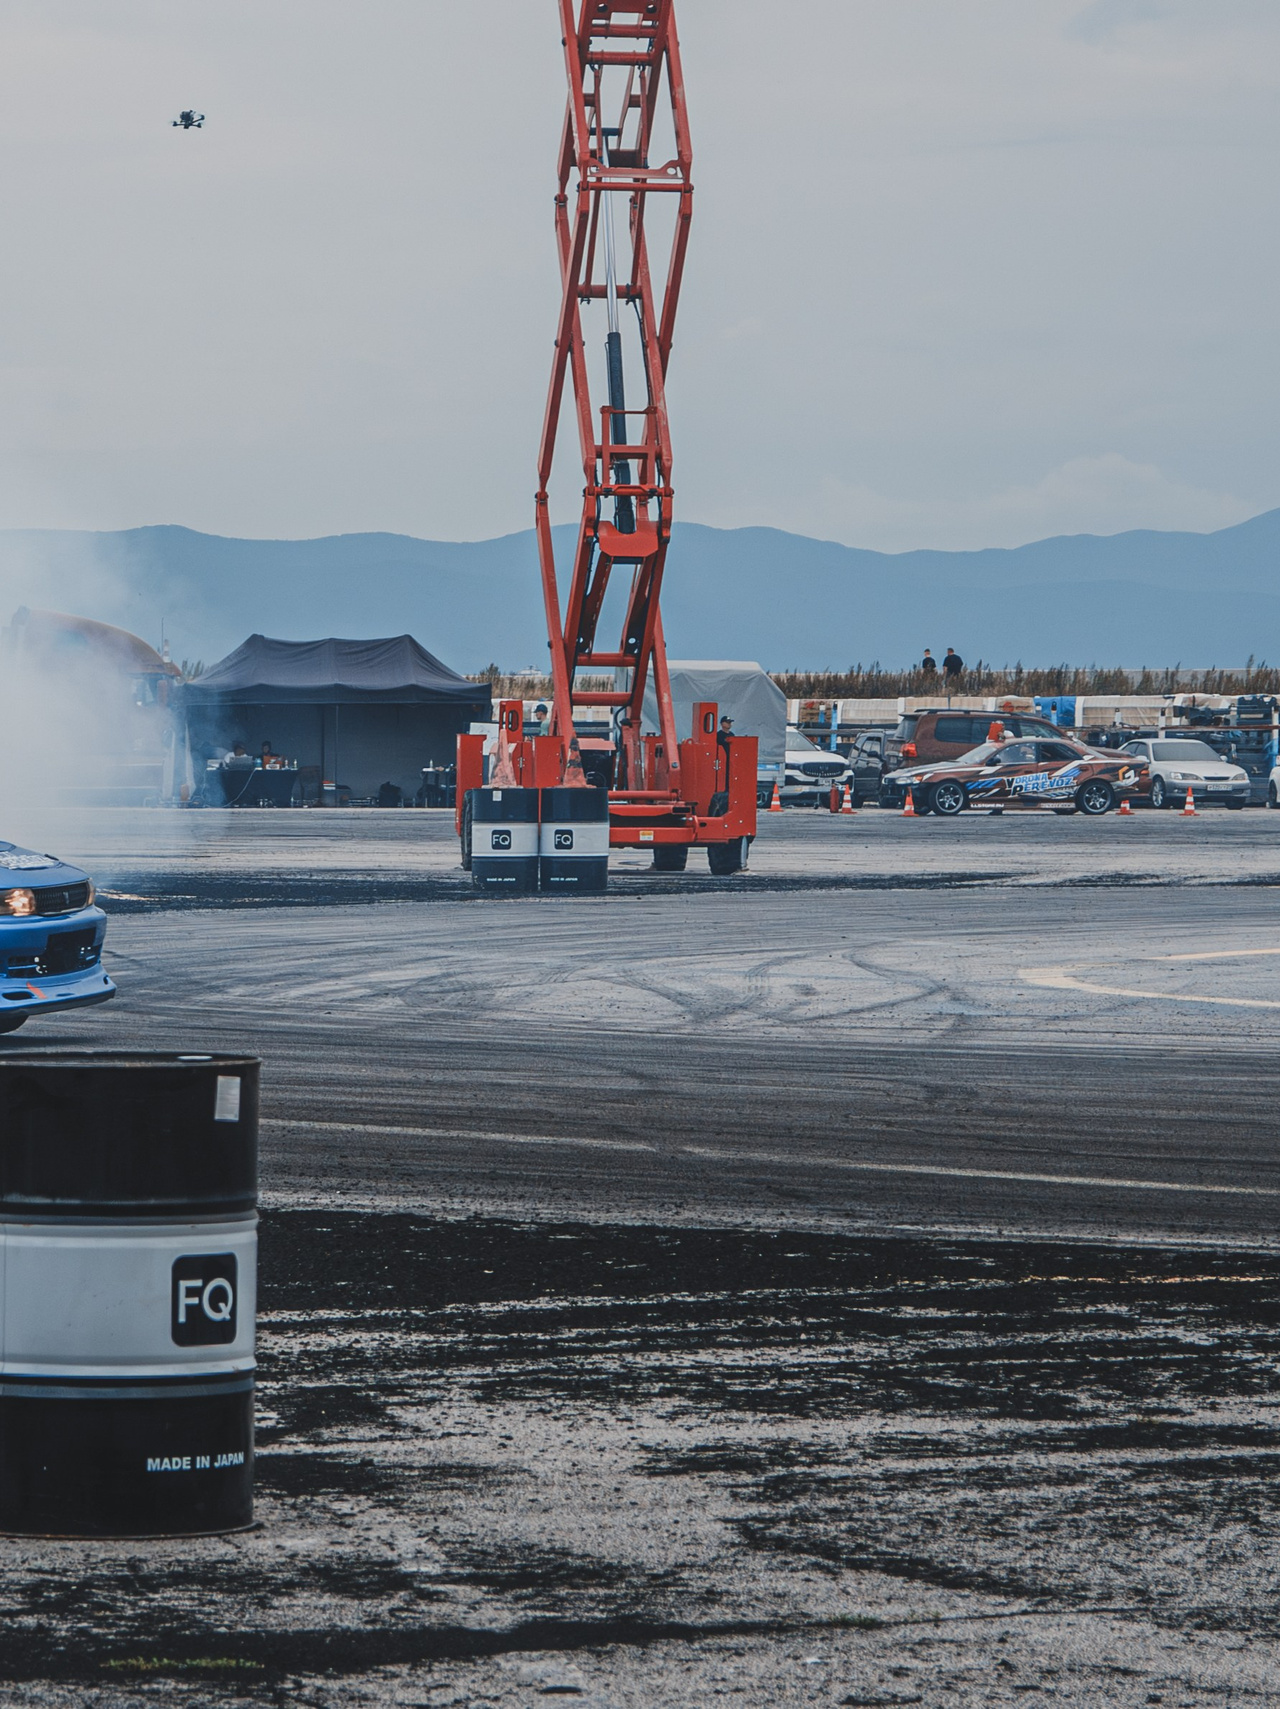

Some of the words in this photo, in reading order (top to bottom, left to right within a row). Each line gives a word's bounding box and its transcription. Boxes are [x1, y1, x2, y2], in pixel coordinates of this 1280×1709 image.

[1011, 776, 1075, 797] PEREVOZ
[492, 834, 510, 846] FQ
[555, 833, 572, 845] FQ
[177, 1277, 234, 1324] FQ
[146, 1456, 192, 1472] MADE
[195, 1455, 211, 1469] IN
[213, 1451, 245, 1467] JAPAN
